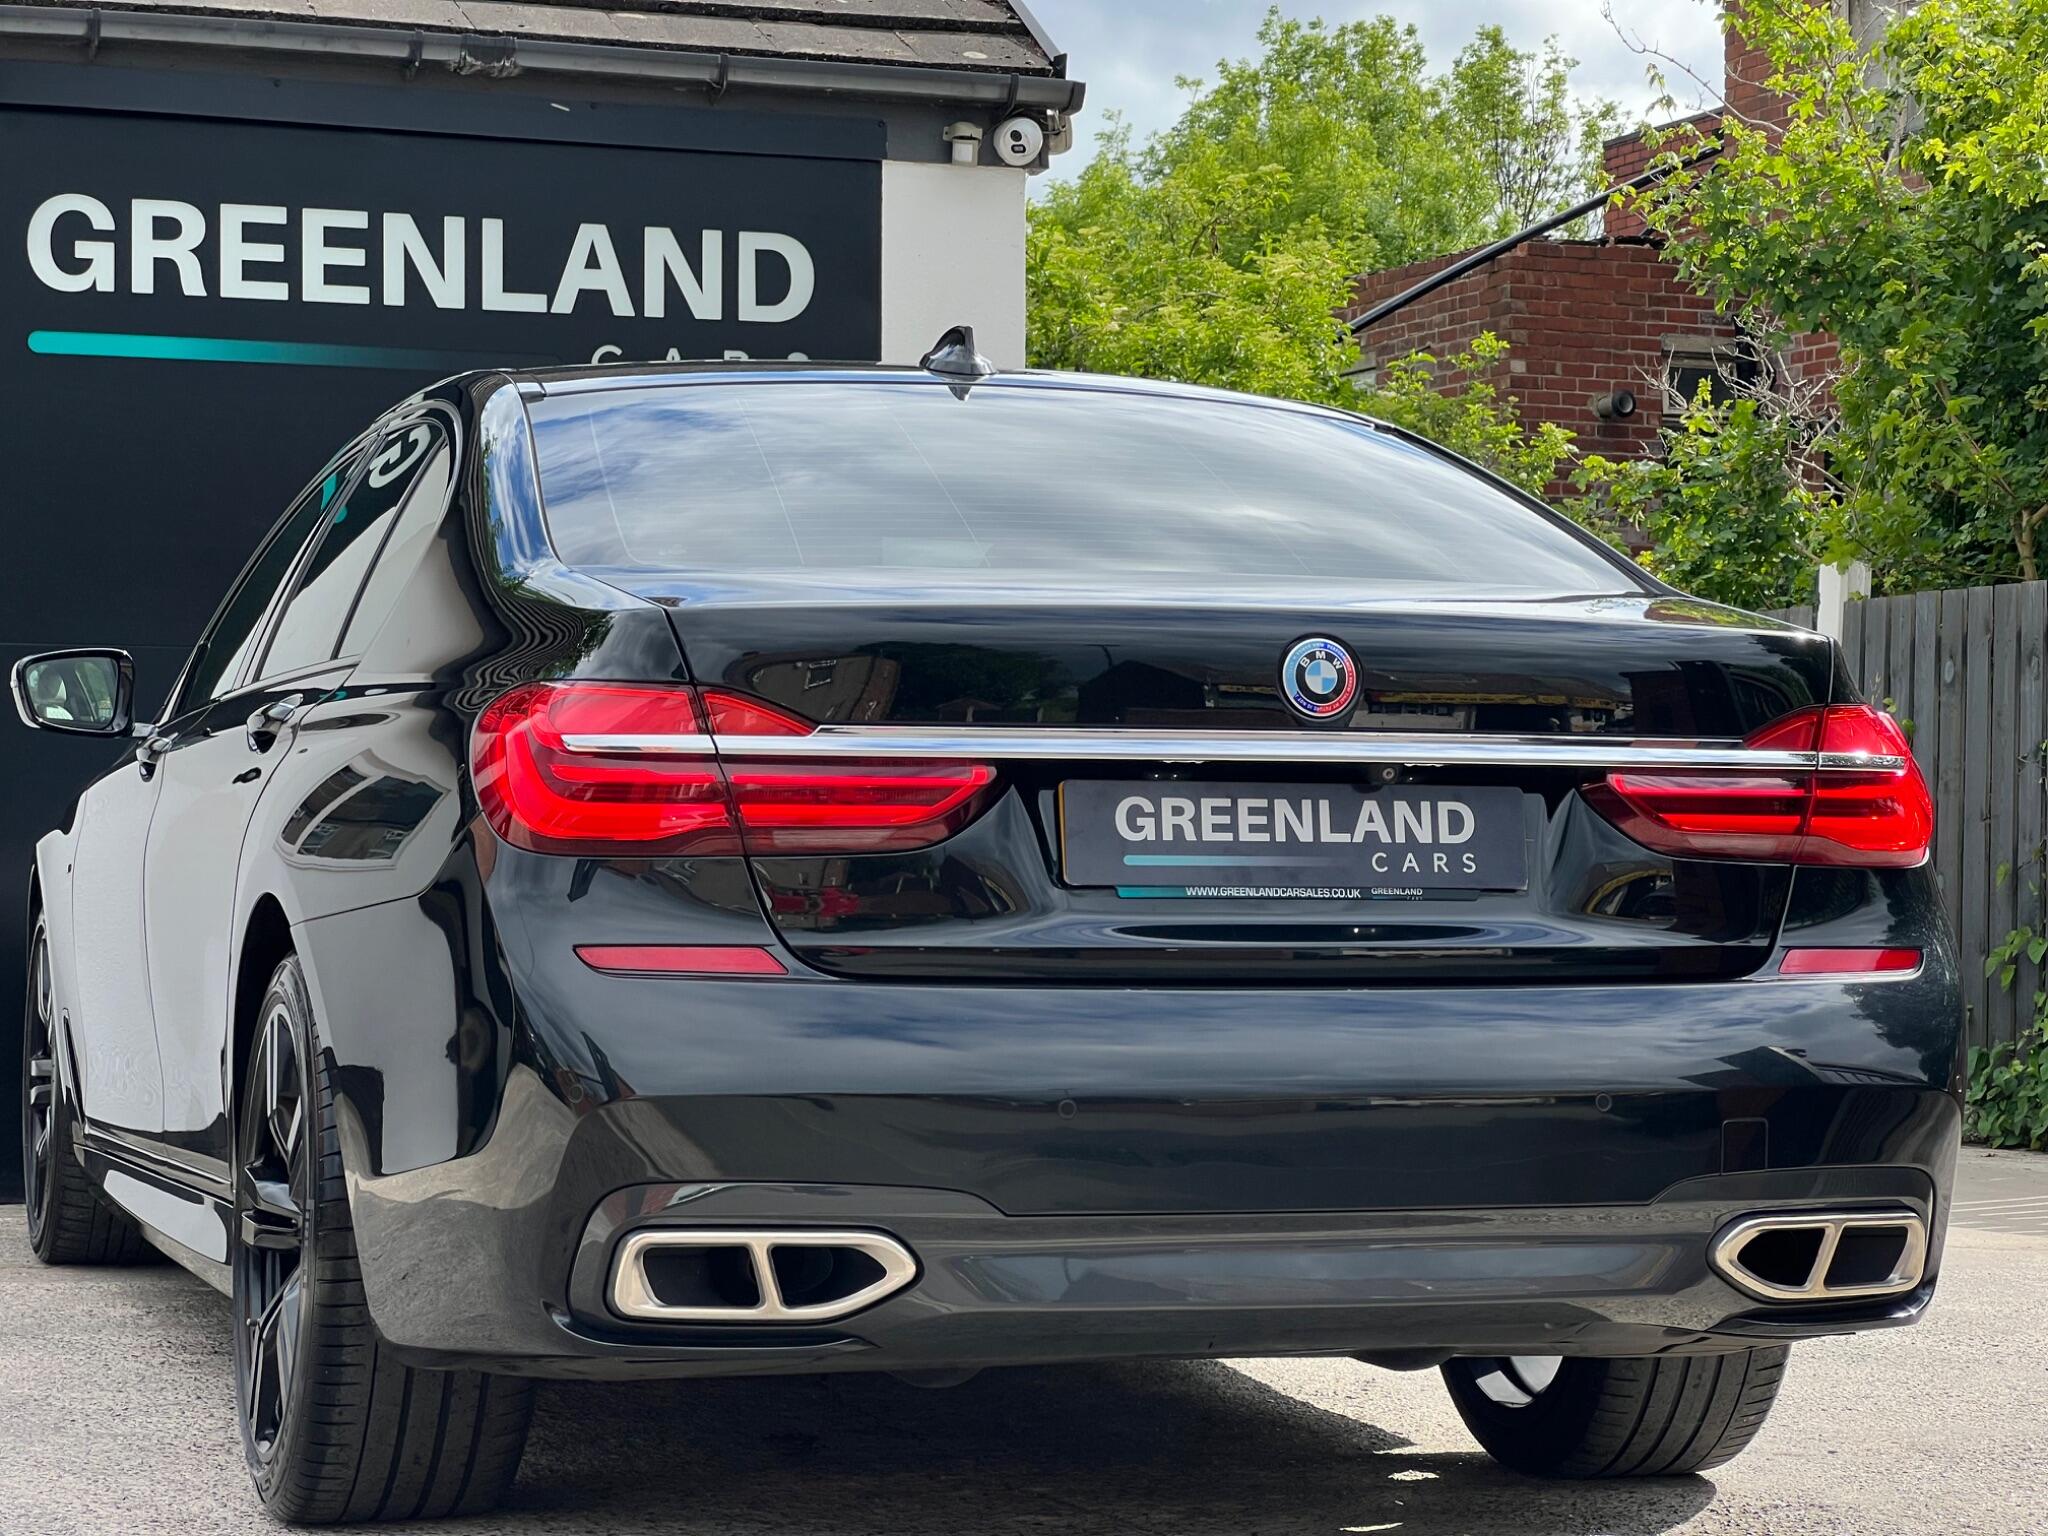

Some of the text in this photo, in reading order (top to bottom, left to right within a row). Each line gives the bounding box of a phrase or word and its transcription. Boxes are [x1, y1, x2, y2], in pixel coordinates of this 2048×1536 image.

[27, 194, 814, 322] GREENLAND
[1300, 651, 1342, 669] BMW
[1115, 797, 1474, 843] GREENLAND
[1372, 853, 1476, 873] CARS
[1185, 886, 1361, 898] WWW.GREENLANDCARSALES.CO.UK
[1370, 887, 1423, 896] GREENLAND
